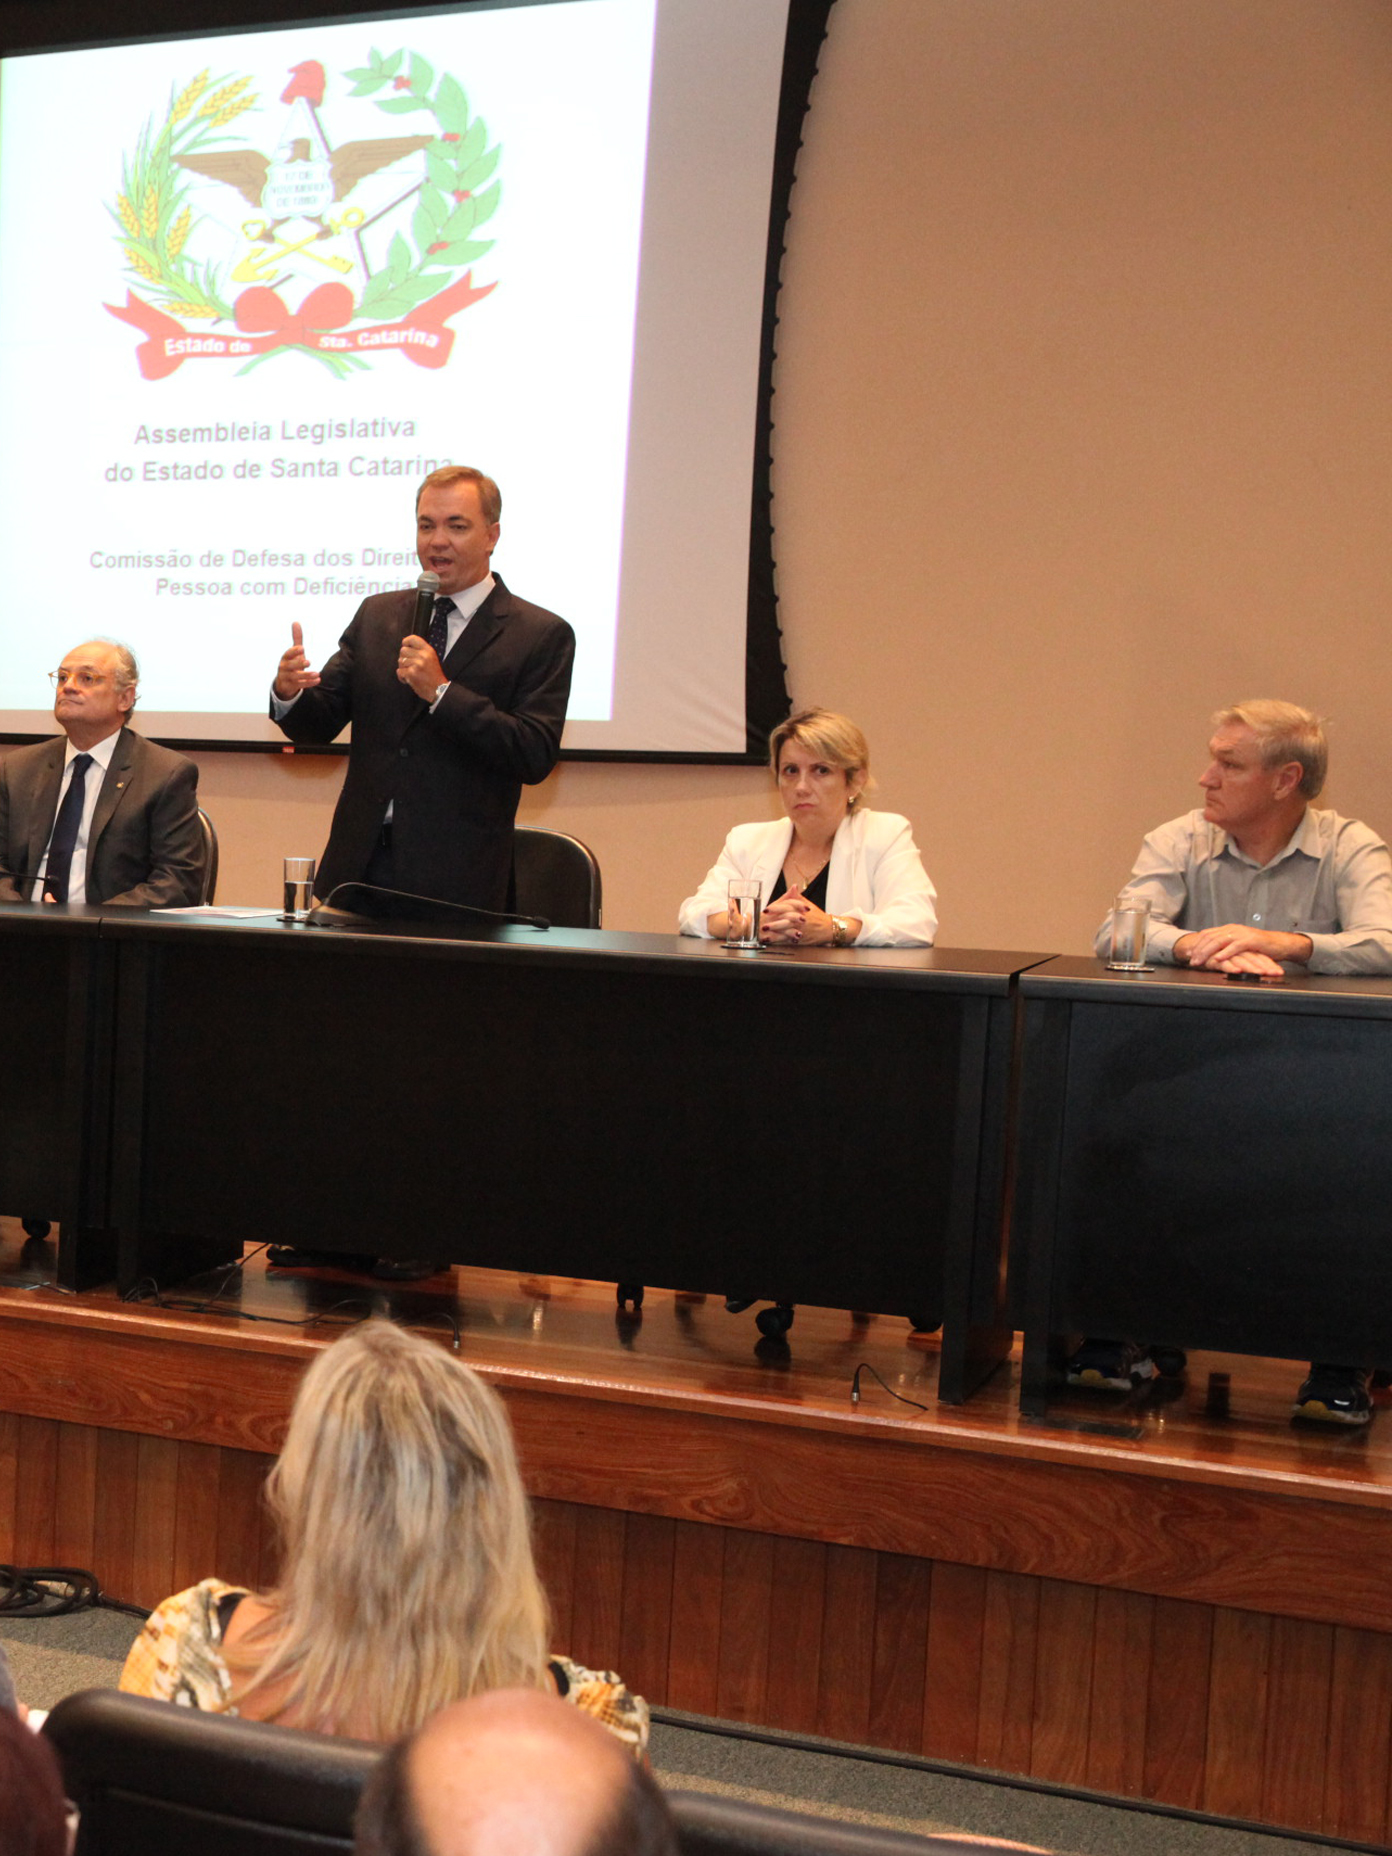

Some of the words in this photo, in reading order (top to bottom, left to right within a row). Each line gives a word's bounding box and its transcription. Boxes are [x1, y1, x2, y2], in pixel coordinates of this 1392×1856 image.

[164, 337, 225, 356] Estado
[229, 339, 251, 353] de
[318, 335, 353, 348] Sta.
[357, 327, 439, 348] Catarina
[134, 421, 271, 445] Assembleia
[281, 417, 416, 445] Legislativa
[104, 462, 133, 482] do
[142, 460, 224, 482] Estado
[232, 459, 261, 479] de
[270, 457, 338, 478] Santa
[89, 549, 192, 569] Comissão
[199, 550, 224, 568] de
[232, 549, 305, 568] Defesa
[313, 548, 353, 567] dos
[361, 548, 419, 566] Direit
[156, 578, 232, 596] Pessoa
[239, 581, 285, 595] com
